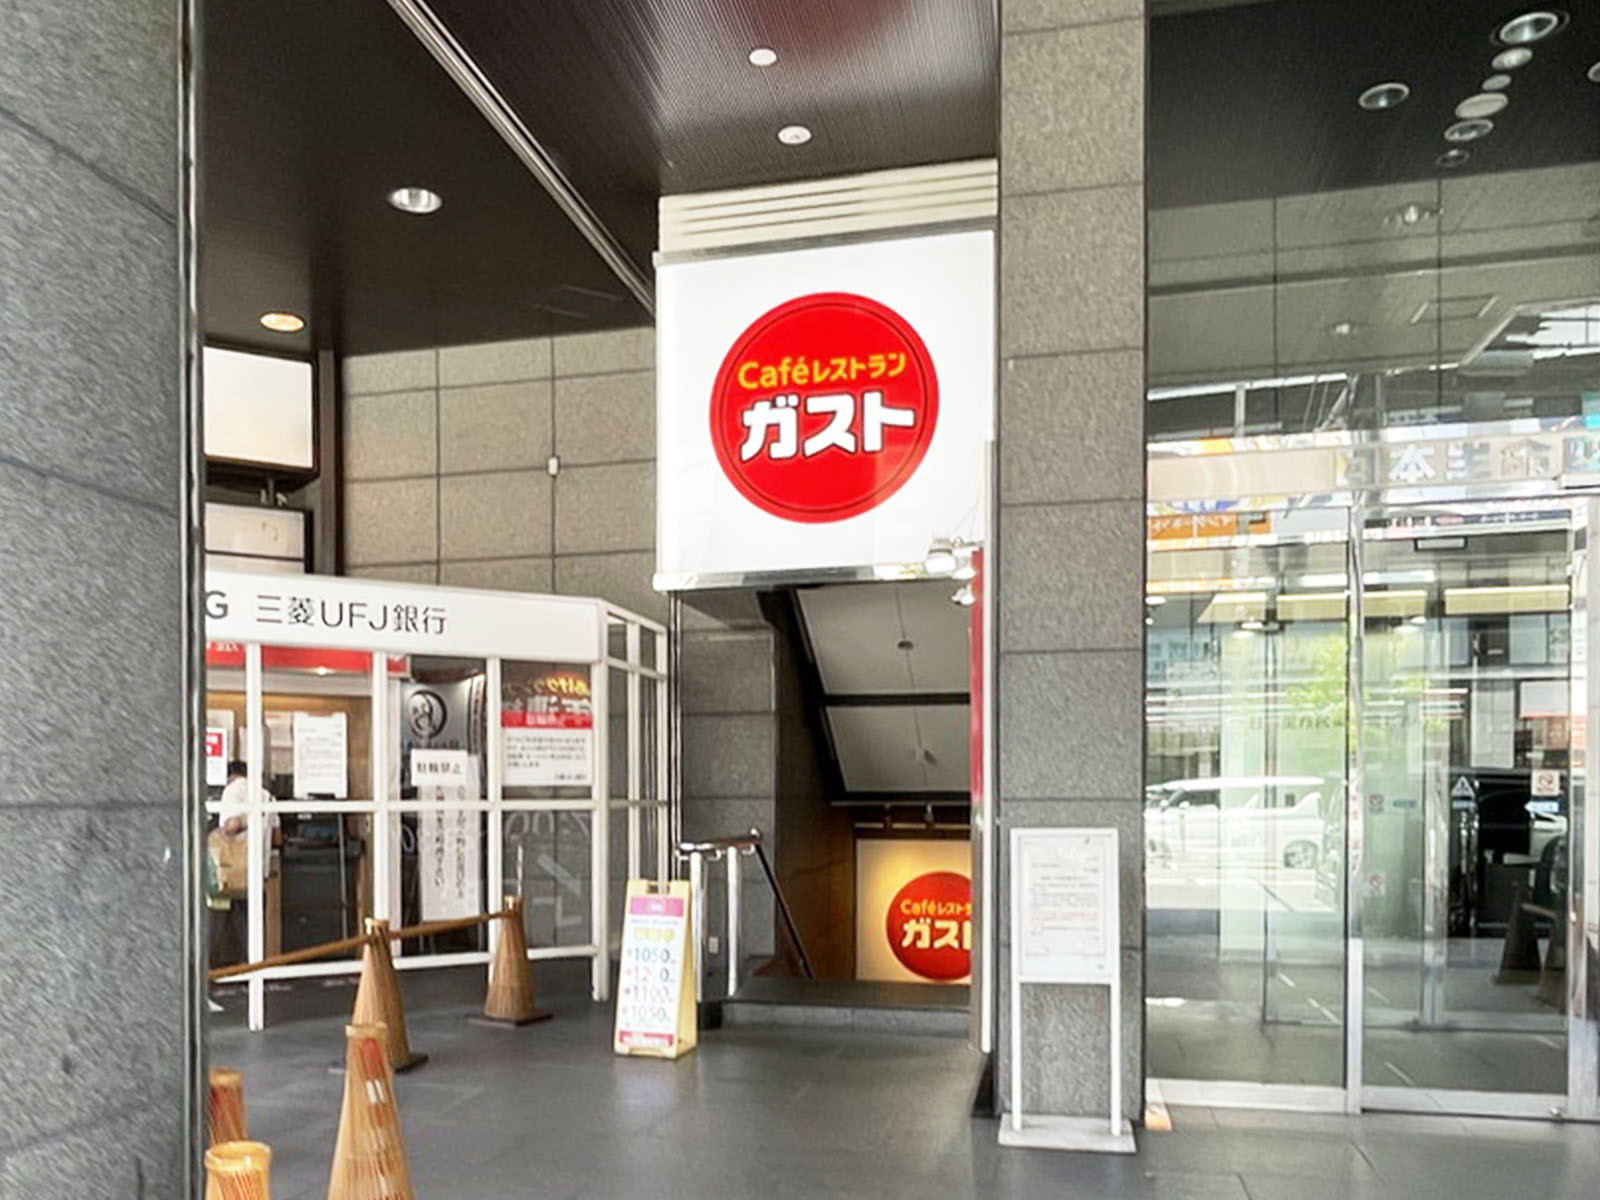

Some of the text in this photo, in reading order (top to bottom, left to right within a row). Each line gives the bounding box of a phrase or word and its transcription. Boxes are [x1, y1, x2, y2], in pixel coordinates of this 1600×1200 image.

[738, 352, 907, 389] Caféレストラン
[740, 390, 916, 462] ガスト
[256, 594, 448, 635] 三菱UFJ銀行
